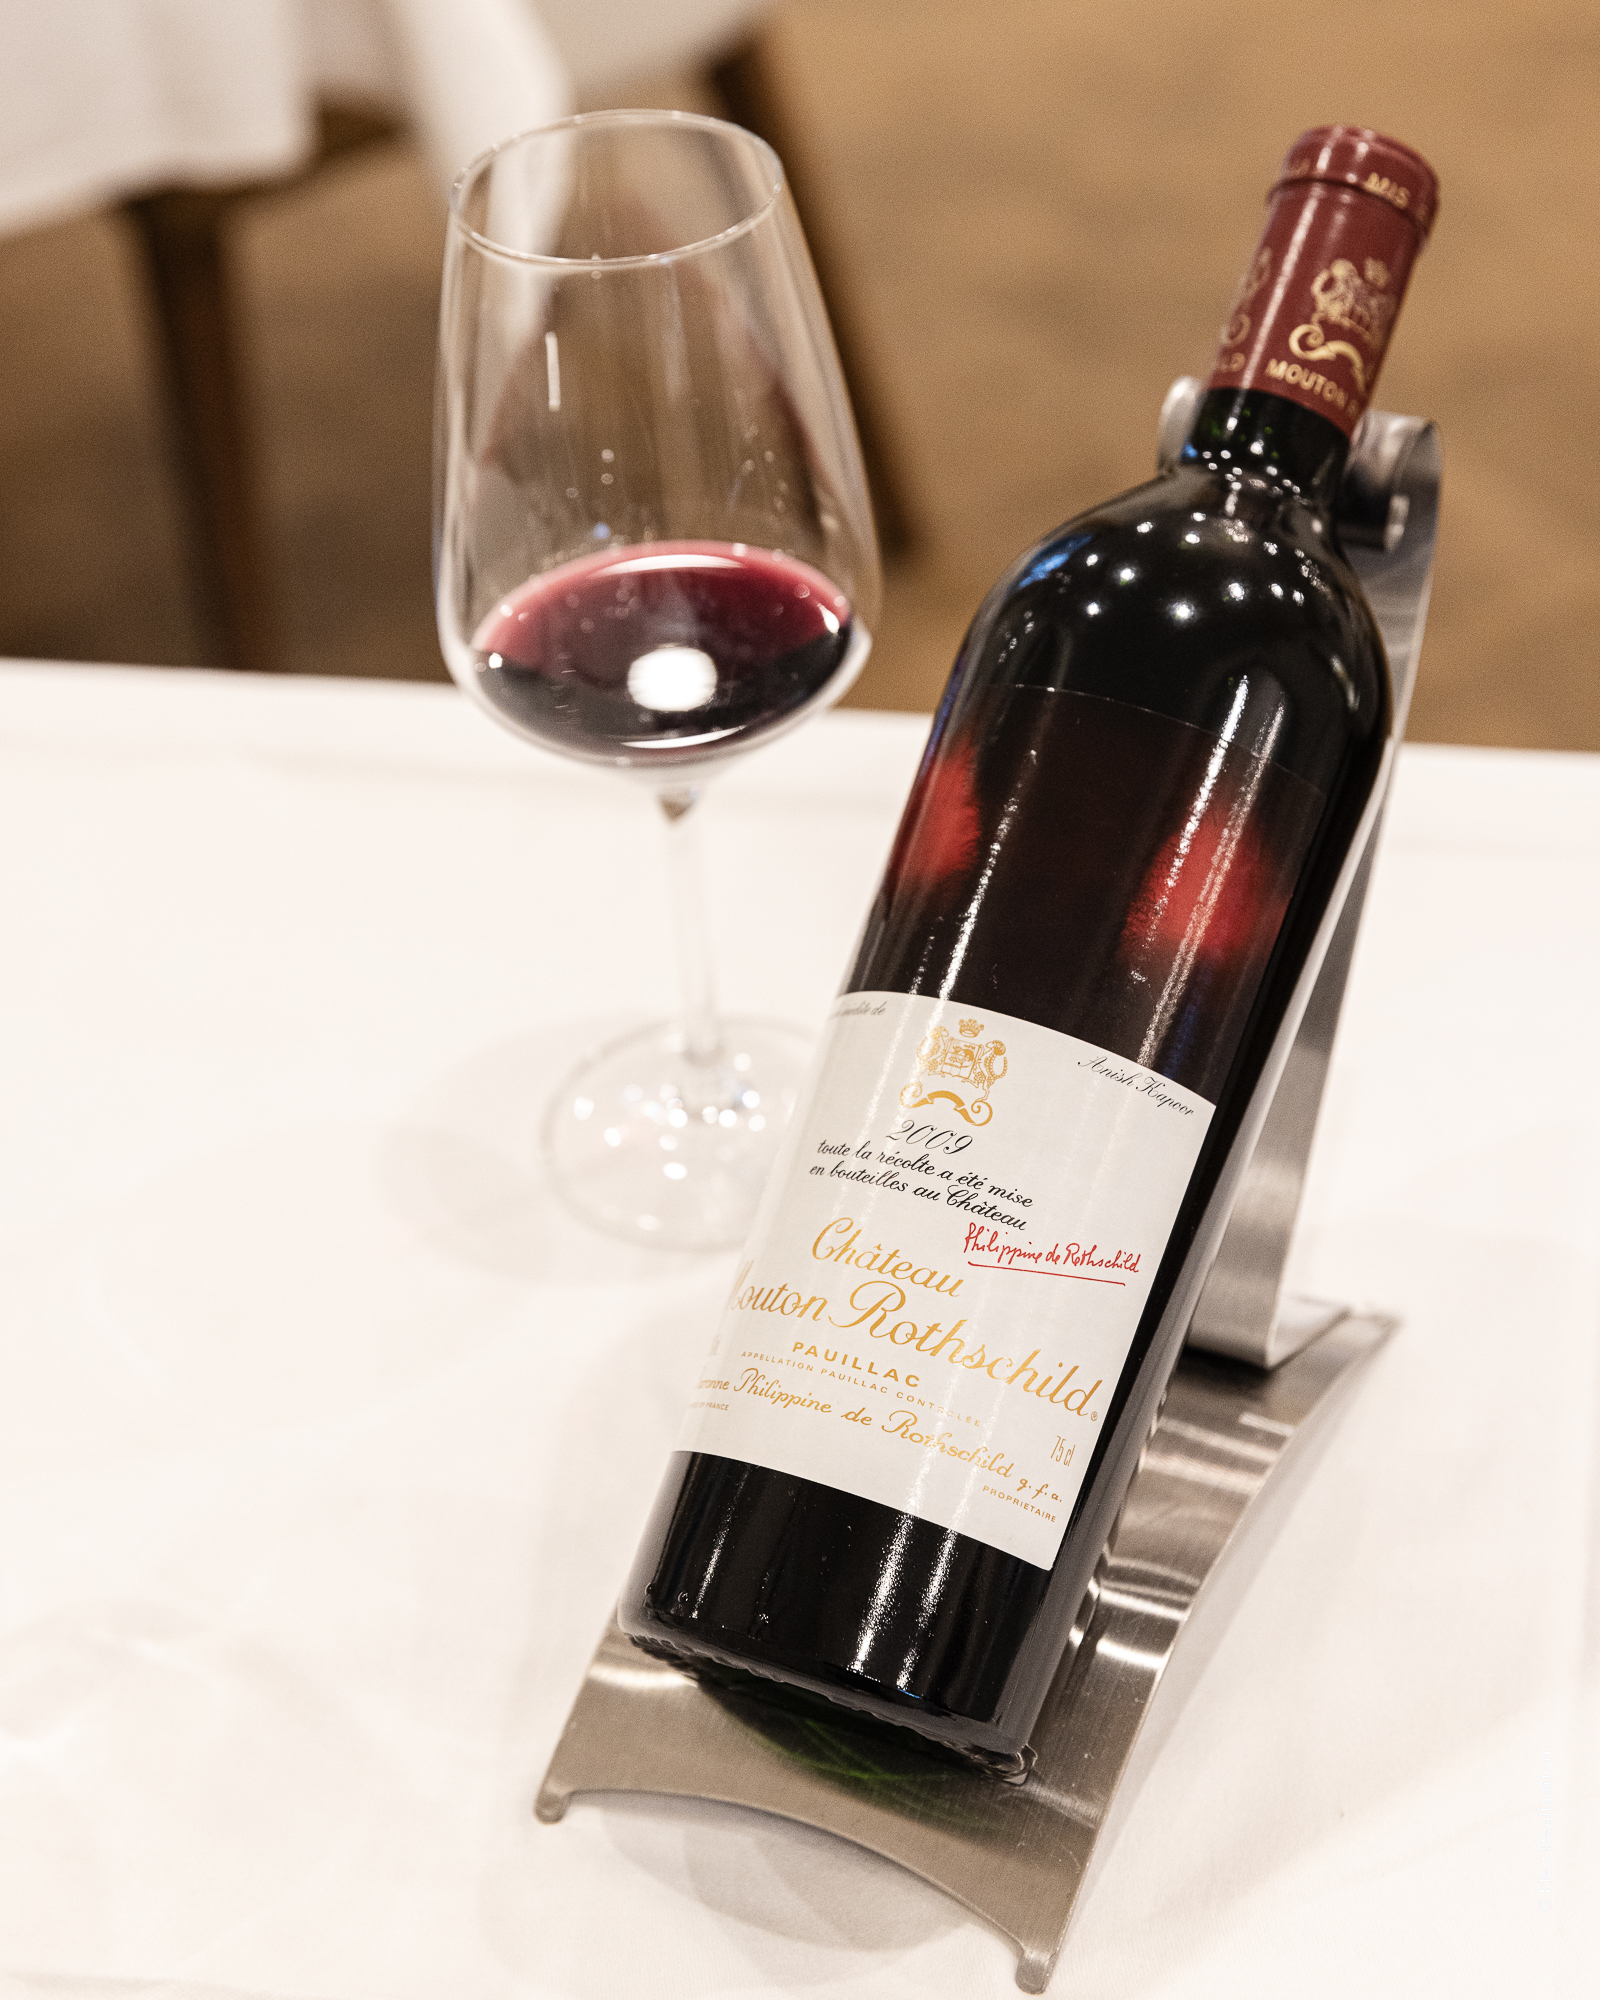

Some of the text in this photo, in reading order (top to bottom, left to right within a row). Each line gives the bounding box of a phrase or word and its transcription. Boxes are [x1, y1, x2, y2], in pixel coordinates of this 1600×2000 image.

[1363, 172, 1411, 209] MIS
[1077, 1055, 1195, 1116] Anish Kapoor
[885, 1119, 974, 1155] 2009
[809, 1160, 1027, 1231] en bouteilles au Château
[817, 1139, 1034, 1208] toute la récolte a été mise
[812, 1217, 964, 1298] Château
[963, 1222, 1142, 1273] Philippine de Rothschild
[741, 1351, 814, 1372] APPELLATION
[820, 1368, 888, 1394] PAUILLAC
[792, 1341, 920, 1388] PAUILLAC
[733, 1367, 832, 1413] Philippine
[840, 1407, 873, 1426] de
[881, 1410, 1014, 1478] Rothschild
[982, 1485, 1057, 1523] PROPRIETAIRE
